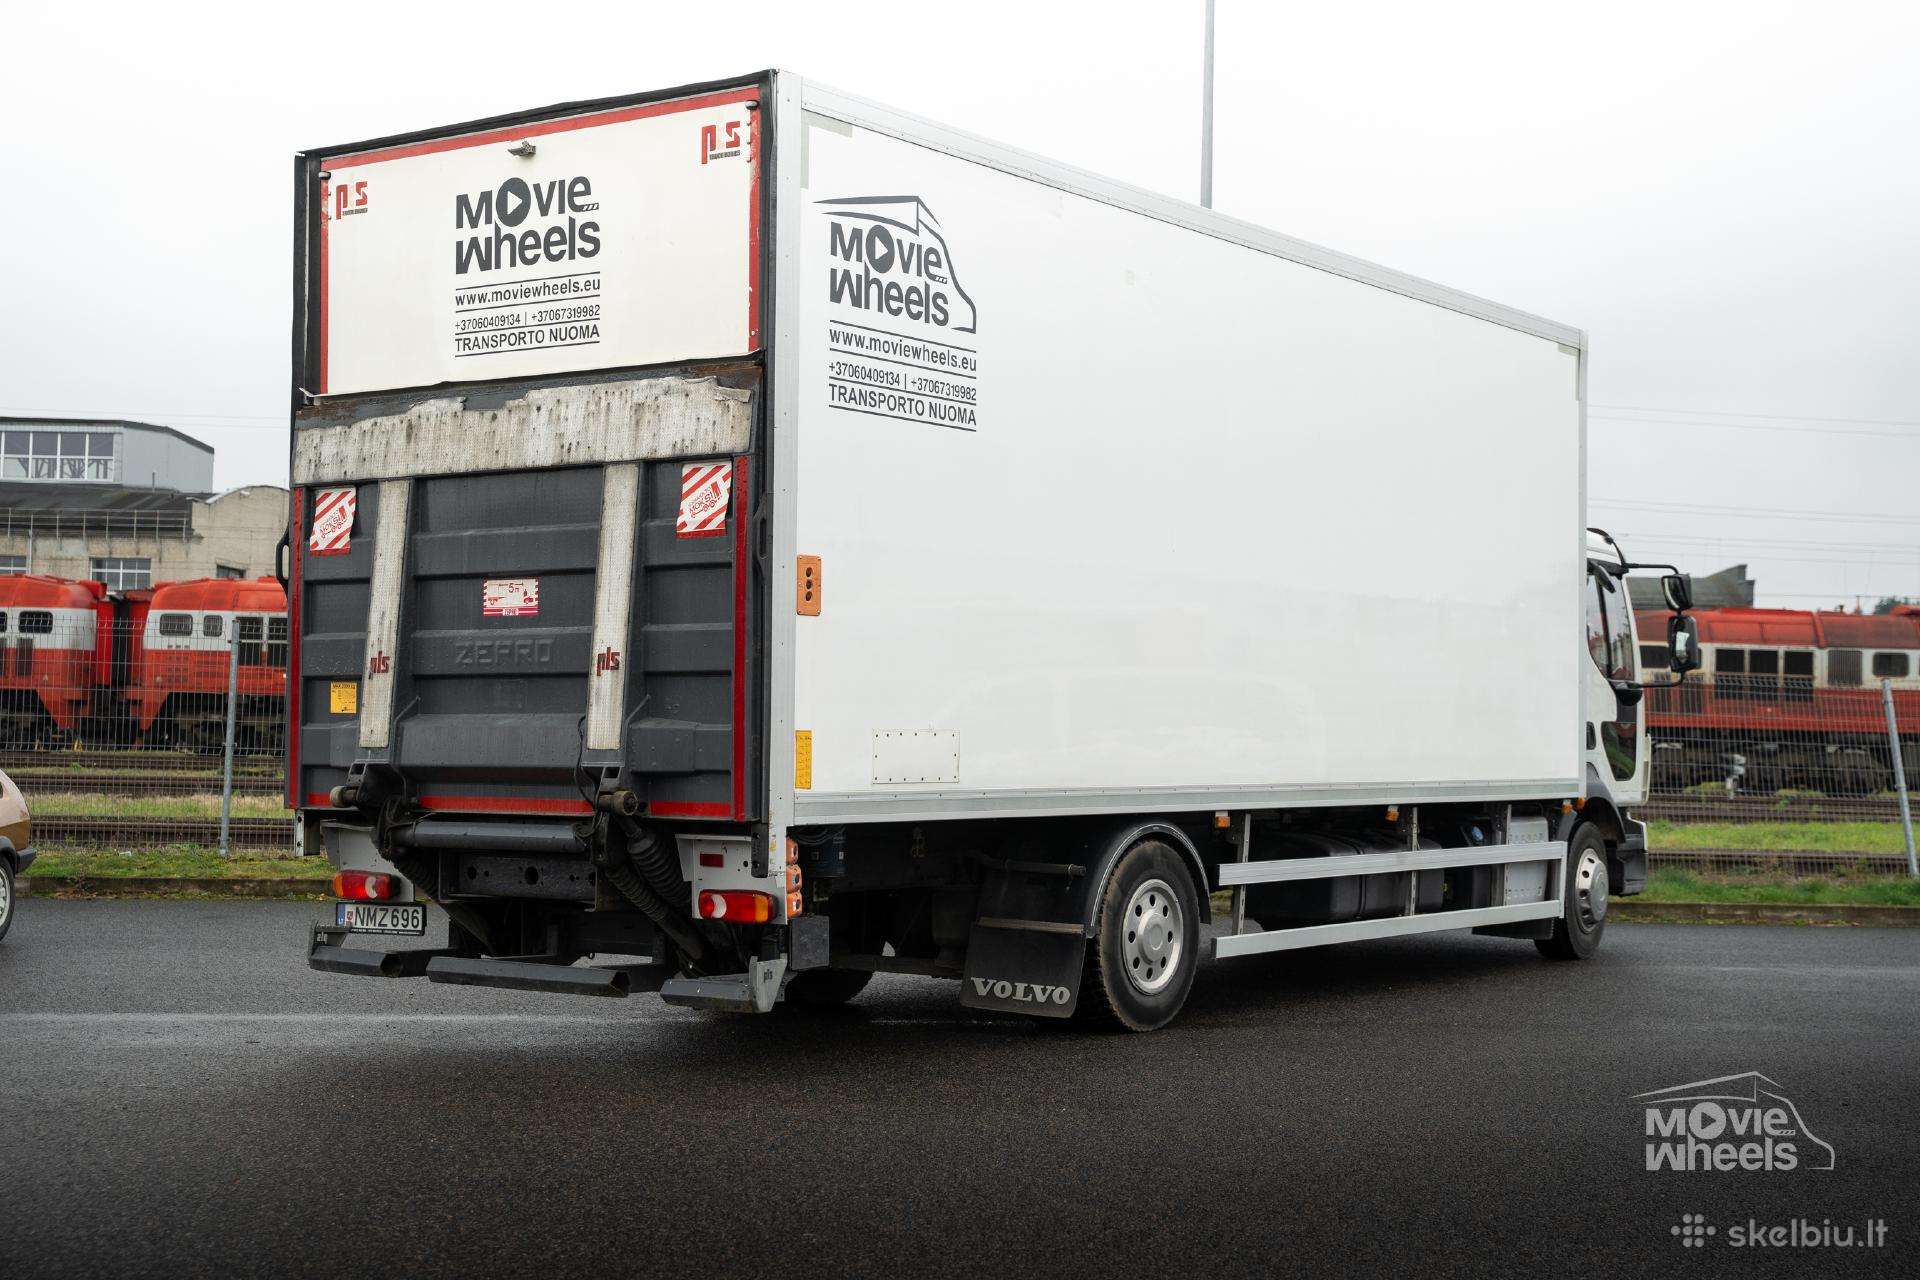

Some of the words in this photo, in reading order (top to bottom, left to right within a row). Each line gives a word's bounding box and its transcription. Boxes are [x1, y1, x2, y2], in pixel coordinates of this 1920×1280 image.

[456, 216, 600, 275] Wheels
[456, 279, 600, 306] www.moviewheels.eu
[829, 261, 949, 327] Wheels
[455, 313, 520, 331] +37060409134
[532, 304, 600, 323] +37067319982
[455, 330, 545, 352] TRANSPORTO
[550, 324, 600, 342] NUOMA
[829, 329, 977, 371] www.moviewheels.eu
[829, 361, 900, 386] +37060409134
[911, 378, 977, 401] +37067319982
[829, 383, 925, 416] TRANSPORTO
[929, 402, 977, 426] NUOMA
[971, 977, 1071, 1004] VOLVO
